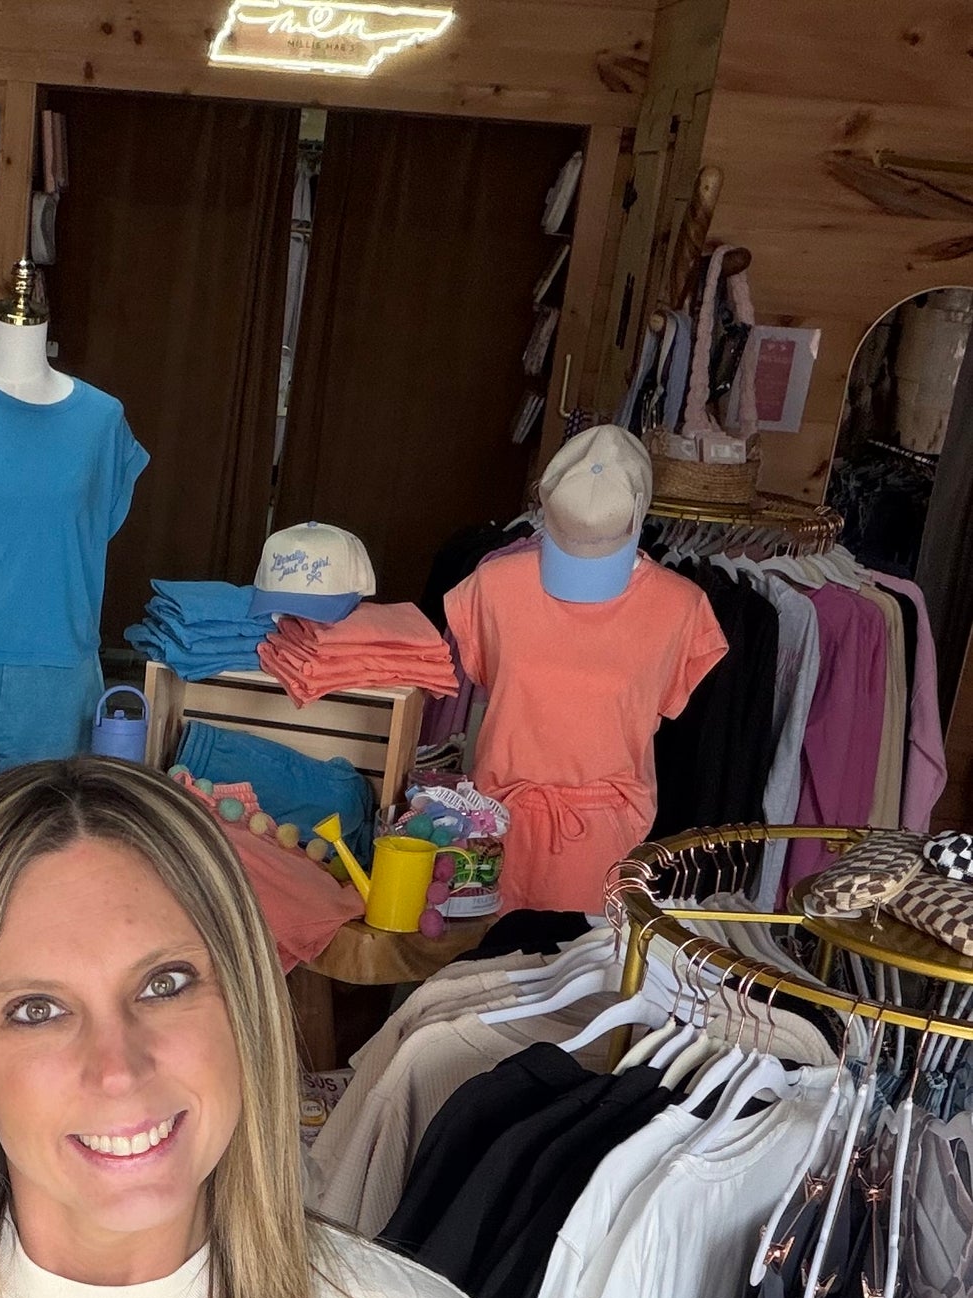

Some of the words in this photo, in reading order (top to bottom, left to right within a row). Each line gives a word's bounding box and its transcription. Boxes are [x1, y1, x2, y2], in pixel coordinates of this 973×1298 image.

[286, 39, 322, 50] MILLIE
[278, 562, 299, 582] just
[301, 563, 309, 571] a
